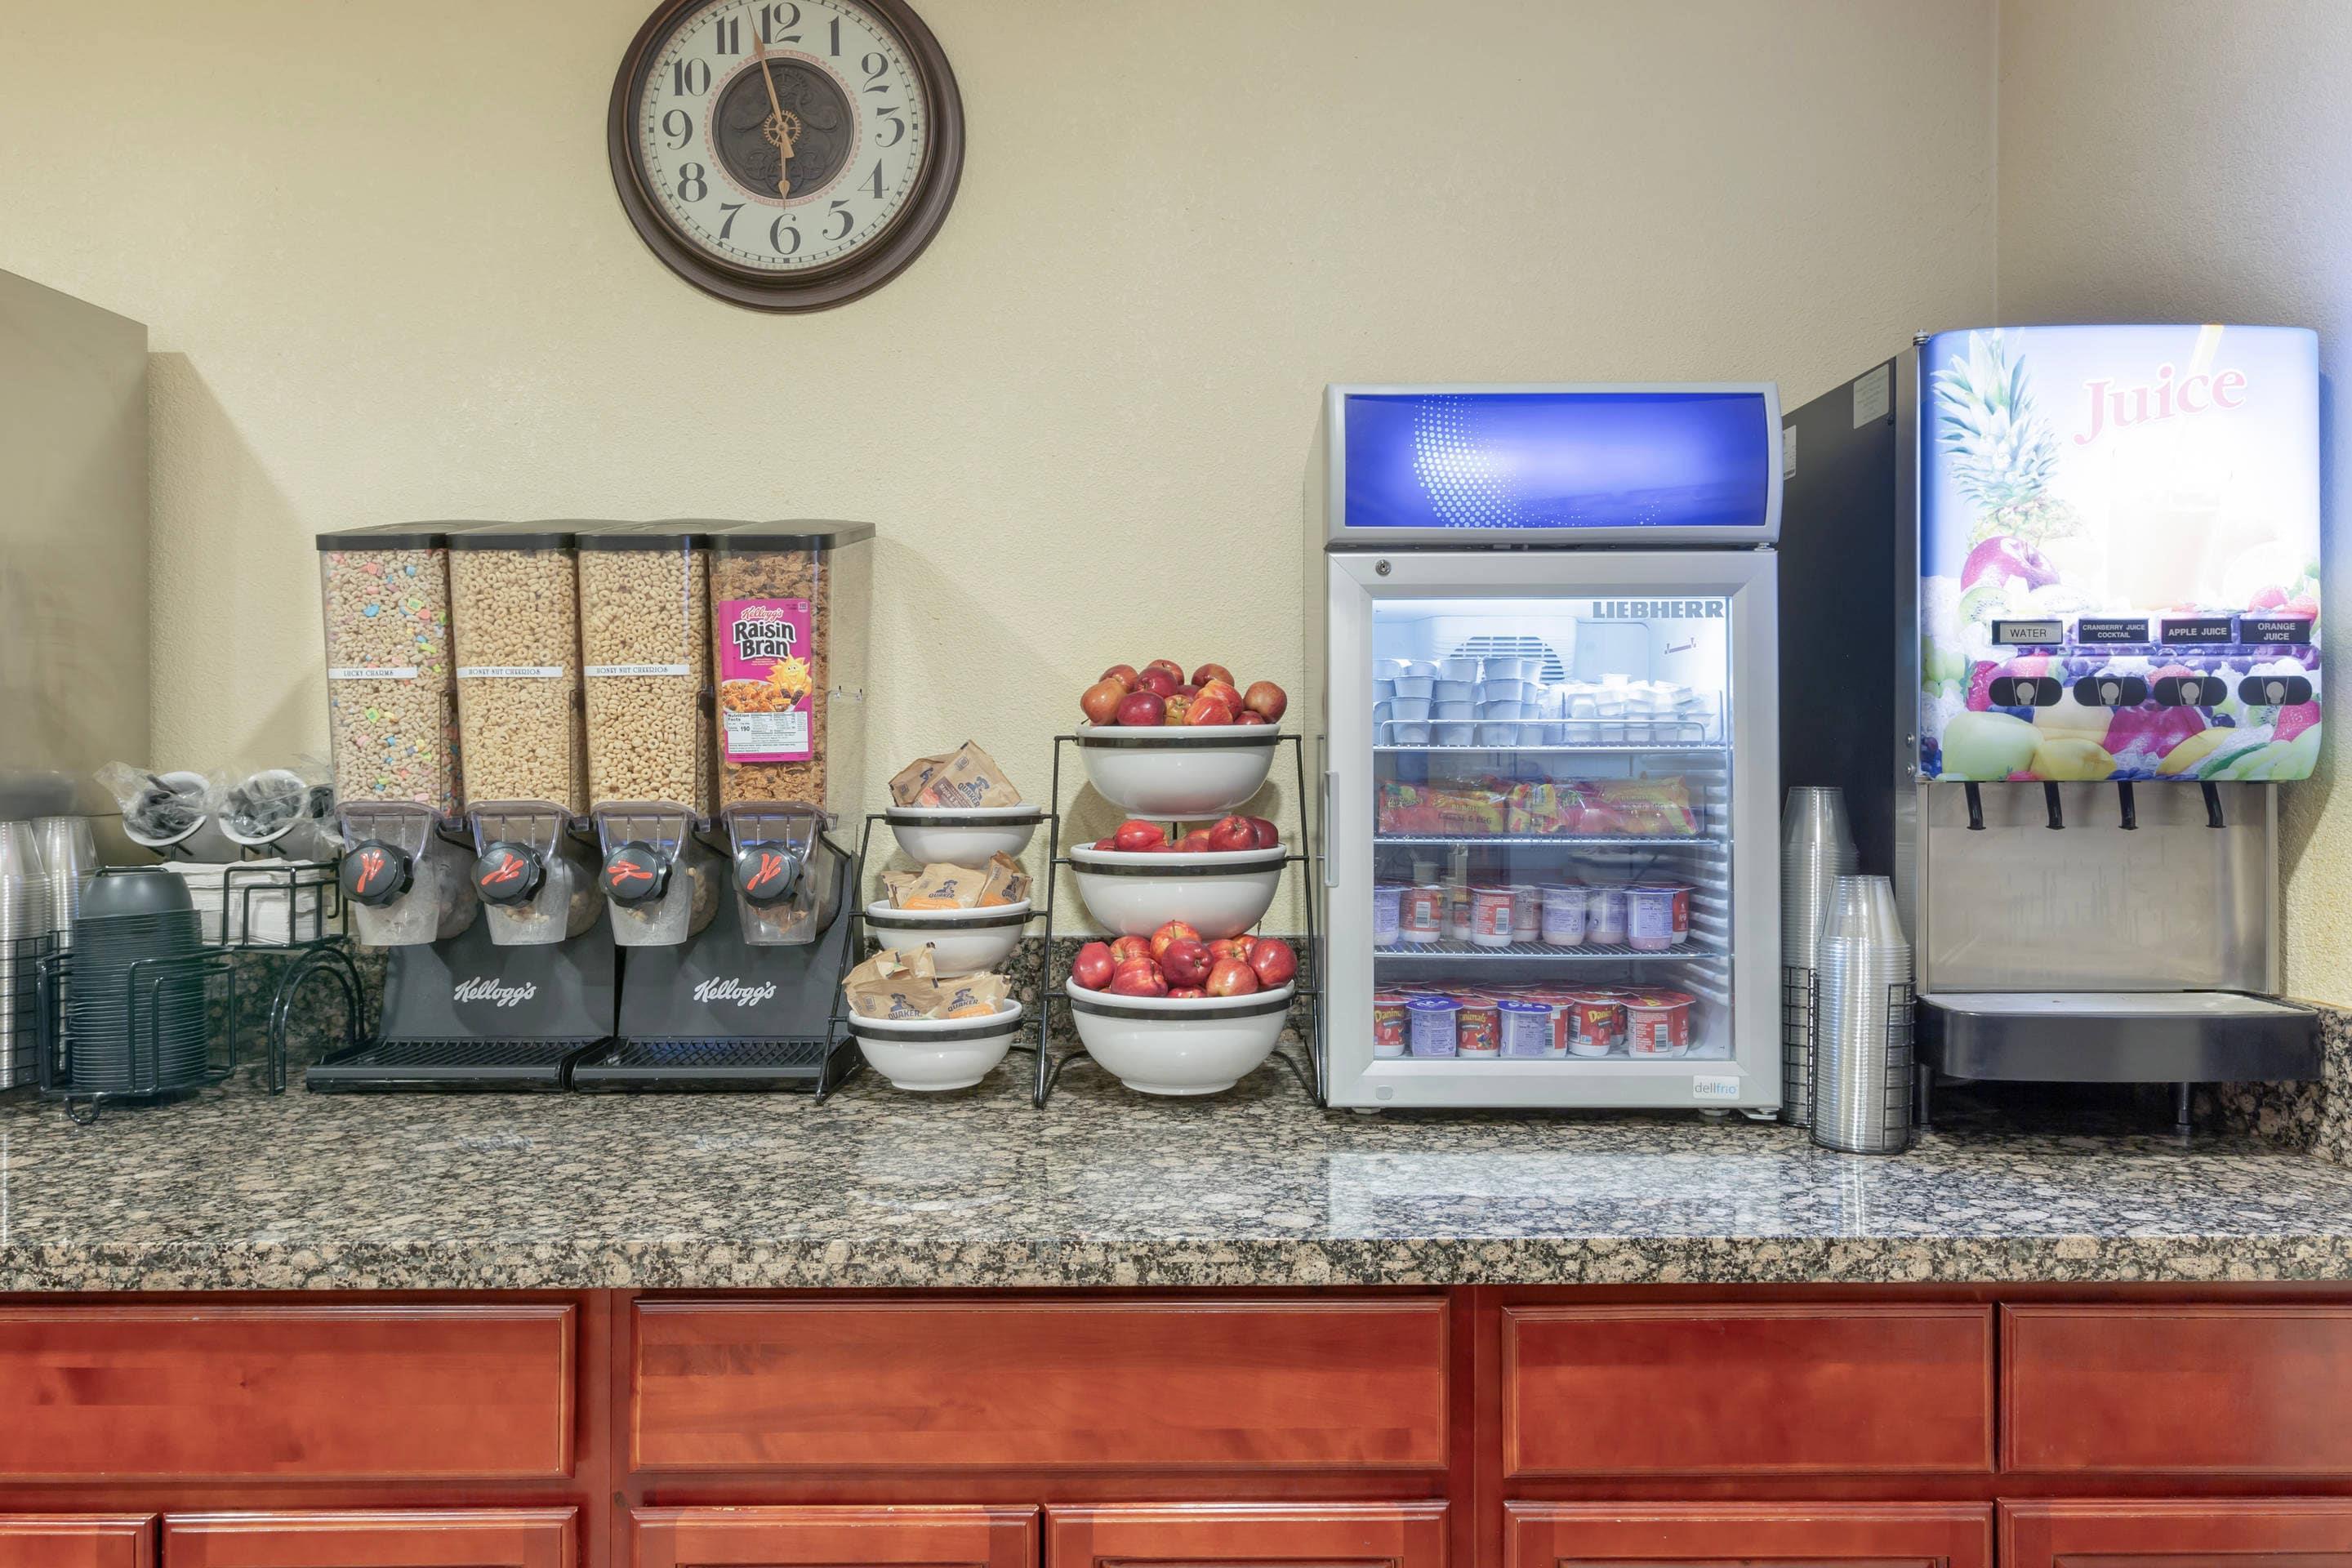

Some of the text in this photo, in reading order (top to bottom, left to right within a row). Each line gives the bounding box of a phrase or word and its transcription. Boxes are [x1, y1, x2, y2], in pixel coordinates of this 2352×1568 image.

[715, 16, 741, 55] 11
[760, 2, 804, 44] 12
[828, 16, 842, 56] 1
[673, 57, 711, 96] 10
[862, 52, 889, 93] 2
[662, 109, 693, 149] 9
[875, 107, 905, 147] 3
[677, 163, 708, 202] 8
[858, 158, 889, 198] 4
[719, 203, 746, 239] 7
[770, 214, 801, 255] 6
[822, 199, 854, 241] 5
[2074, 366, 2246, 445] Juice
[741, 606, 784, 621] Kellogg's
[1592, 601, 1725, 618] LIEBHERR
[2257, 622, 2296, 630] ORANGE
[733, 621, 796, 644] Raisin
[742, 639, 790, 659] Bran
[2010, 629, 2047, 638] WATER
[2168, 627, 2227, 636] APPLE JUICE
[957, 782, 981, 807] QUAKER
[454, 976, 537, 1007] Kellogg's
[693, 976, 777, 1007] Kellogg's
[947, 999, 979, 1013] QUAKER
[888, 1009, 921, 1020] QUAKER
